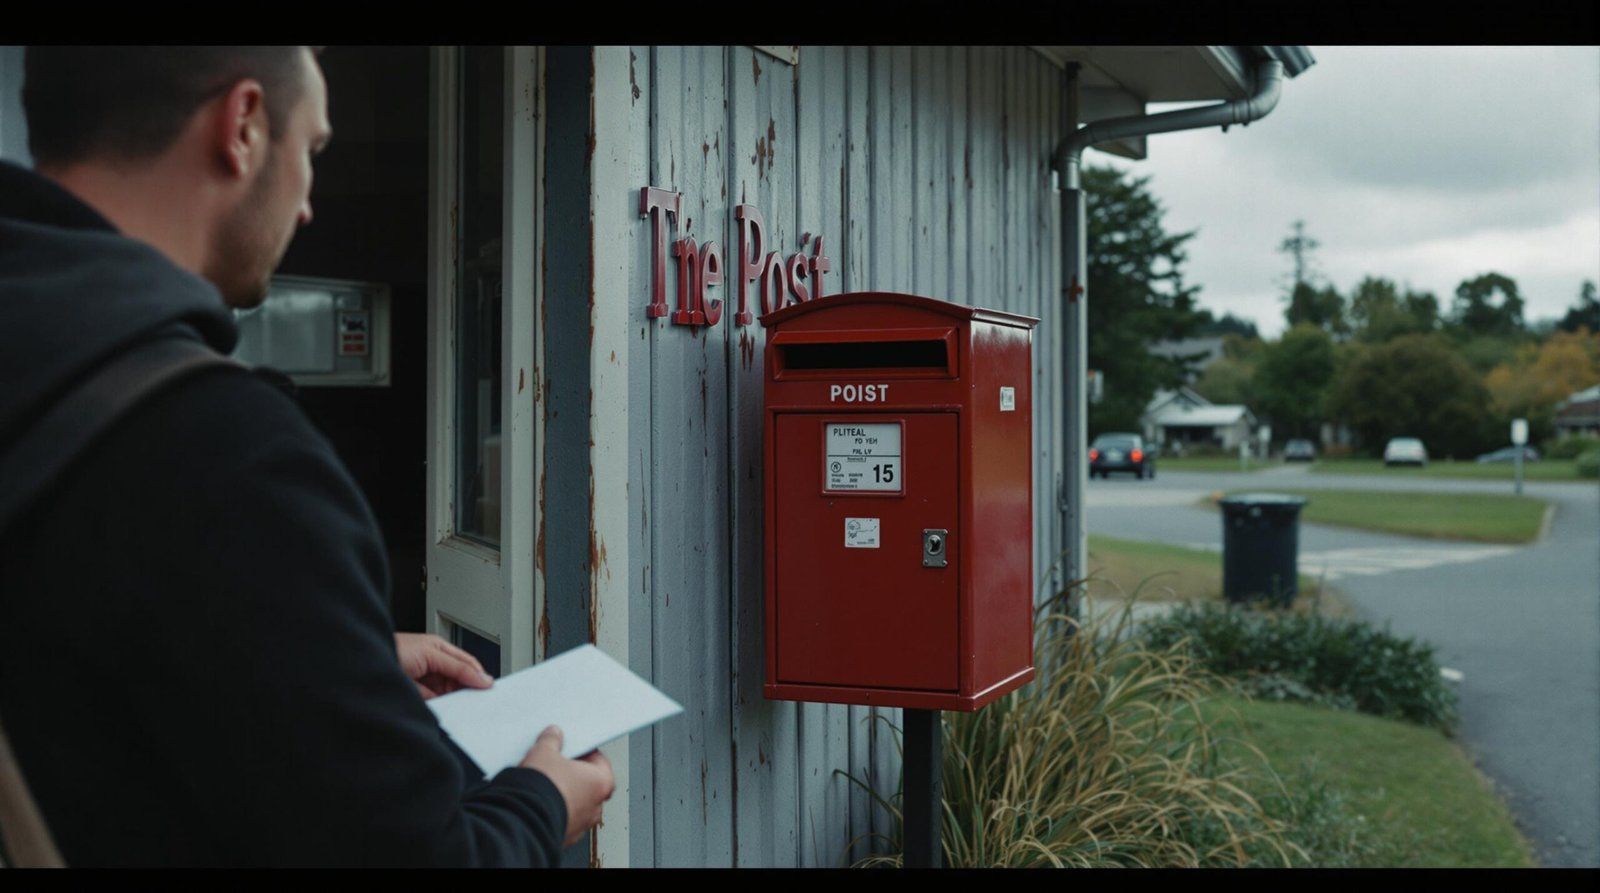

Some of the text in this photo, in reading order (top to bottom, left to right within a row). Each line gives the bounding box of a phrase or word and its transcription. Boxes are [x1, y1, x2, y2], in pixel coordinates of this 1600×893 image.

[735, 203, 830, 326] Post
[830, 384, 889, 402] POIST
[833, 428, 866, 437] PLITEAL
[873, 464, 894, 483] 15
